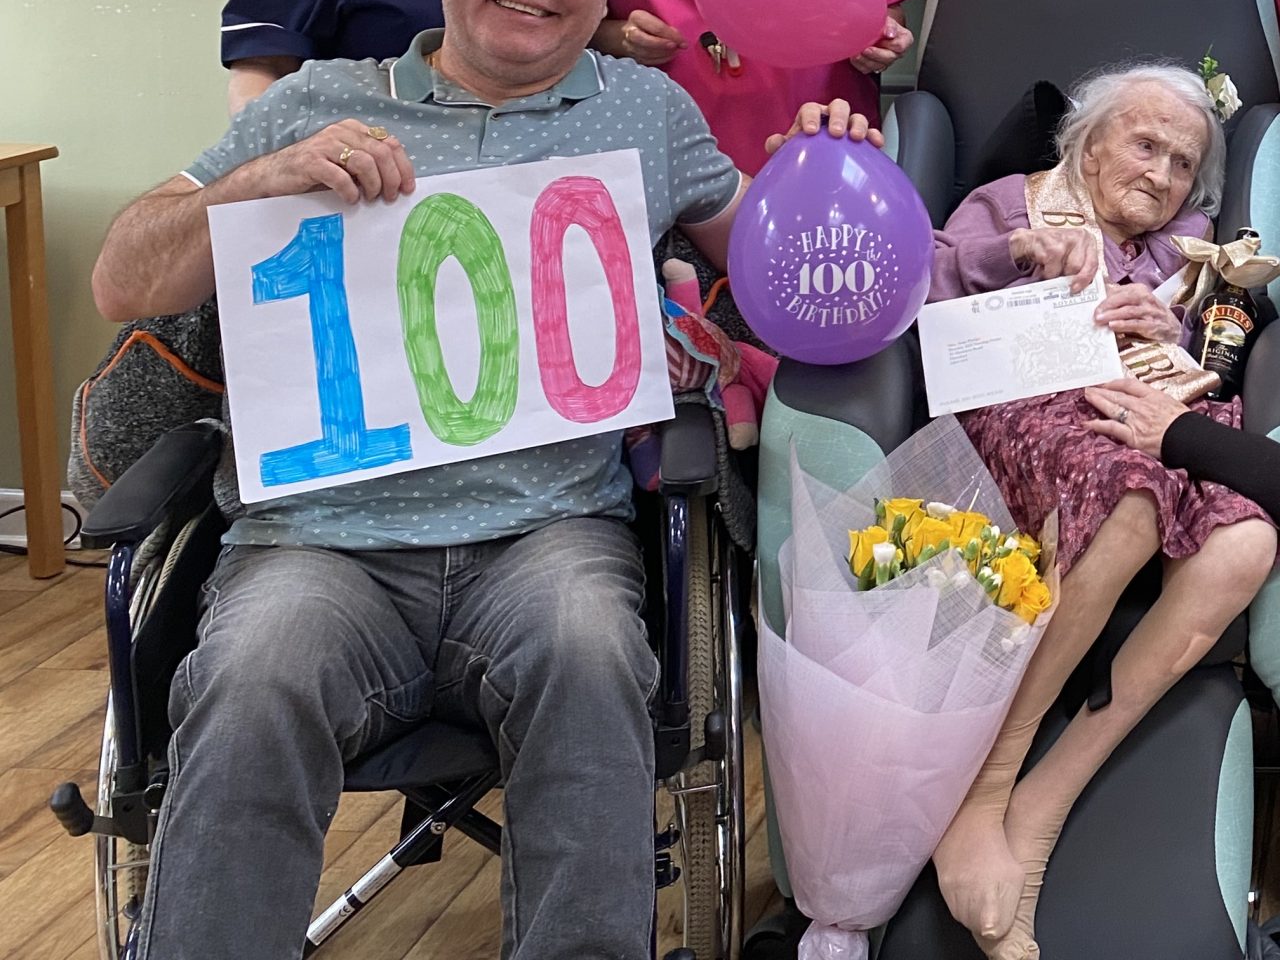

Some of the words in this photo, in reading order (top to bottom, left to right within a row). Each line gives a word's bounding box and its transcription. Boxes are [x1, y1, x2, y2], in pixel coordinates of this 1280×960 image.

[800, 223, 868, 253] HAPPY
[785, 291, 884, 328] BIRTHDAY!
[1205, 307, 1251, 329] BAILEYS
[250, 176, 642, 487] 100
[1202, 347, 1238, 361] RIGINAL
